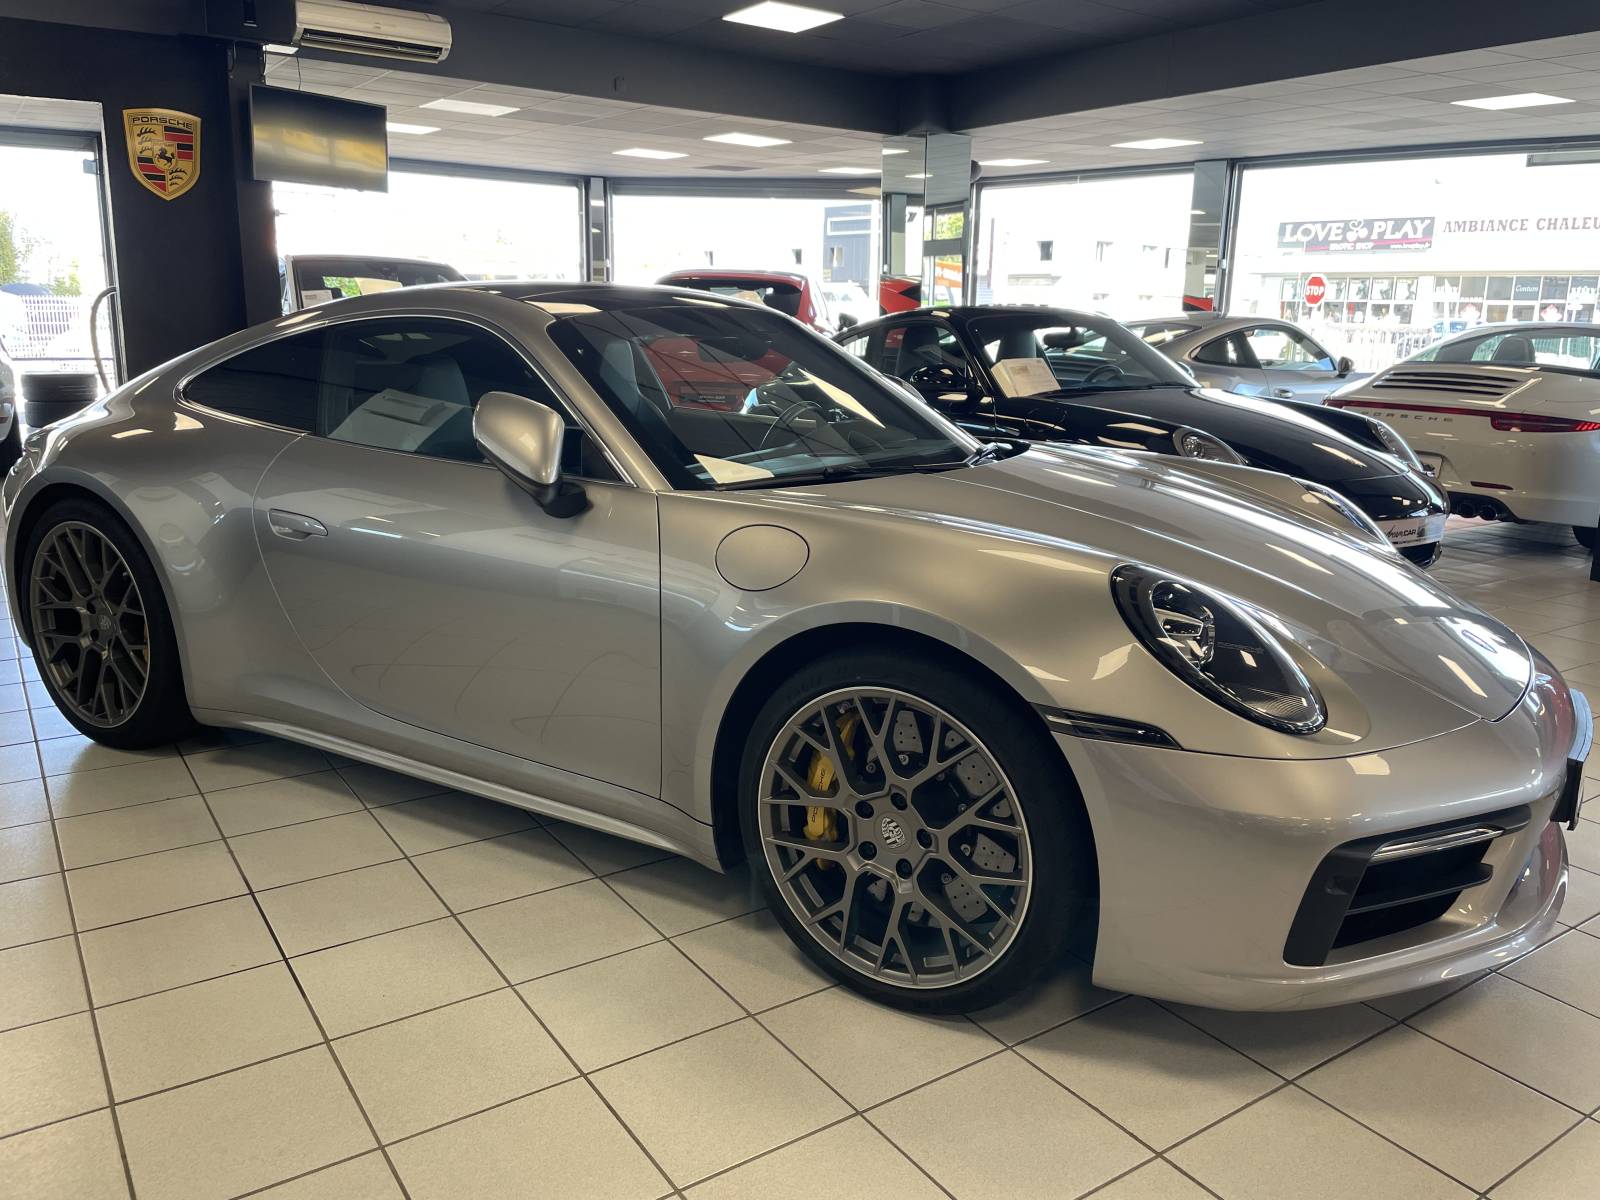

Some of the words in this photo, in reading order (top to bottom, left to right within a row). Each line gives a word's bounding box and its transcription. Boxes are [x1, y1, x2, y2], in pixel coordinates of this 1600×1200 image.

[132, 116, 193, 130] PORSCHE
[1283, 222, 1345, 243] LOVE
[1370, 219, 1432, 240] PLAY
[1443, 218, 1529, 233] AMBIANCE
[1305, 285, 1325, 297] STOP
